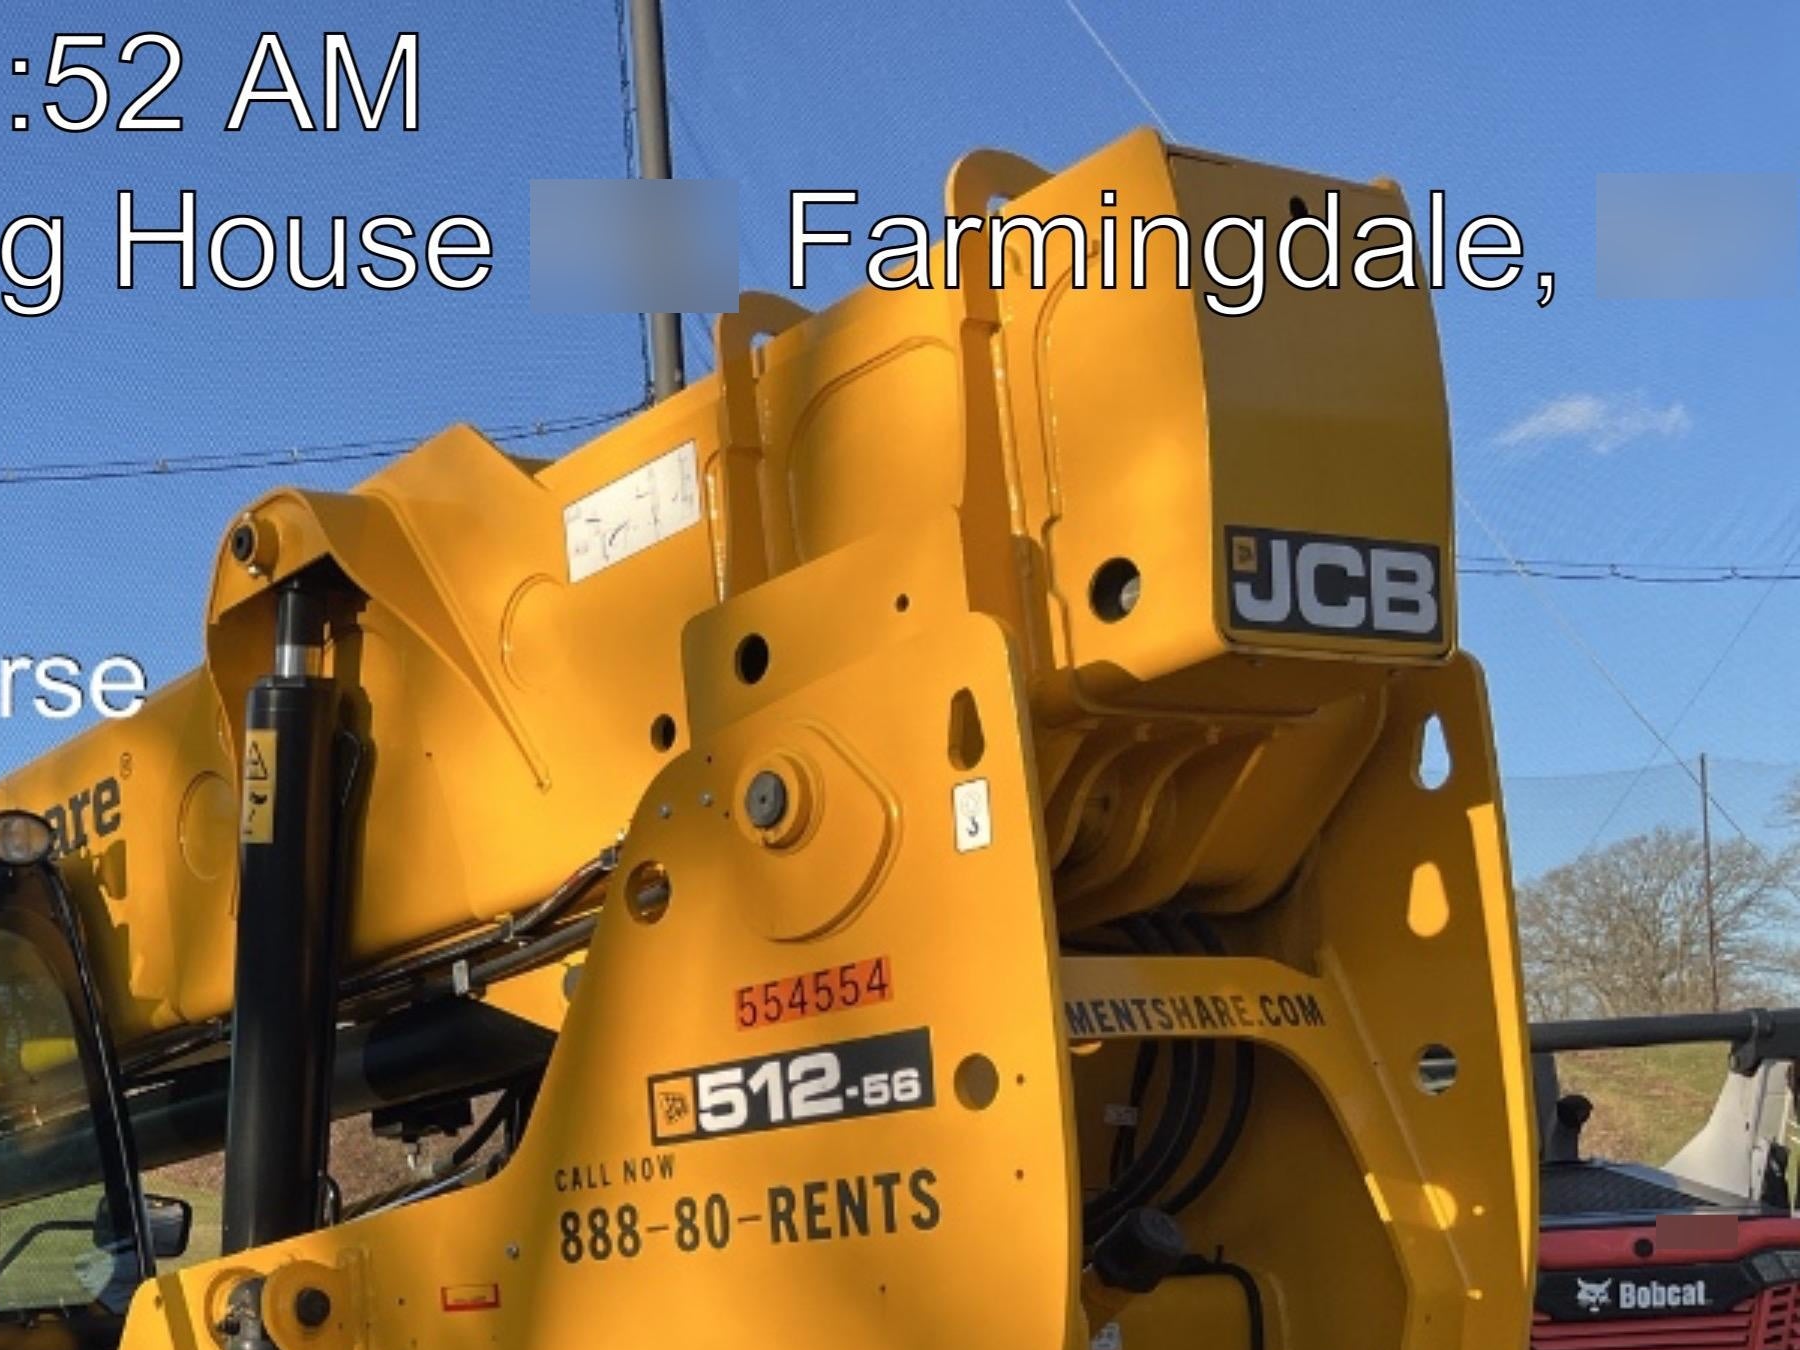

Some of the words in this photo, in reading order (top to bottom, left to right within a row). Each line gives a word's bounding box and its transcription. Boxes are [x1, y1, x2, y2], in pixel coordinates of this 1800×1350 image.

[1233, 538, 1438, 634] JCB
[737, 957, 889, 1029] 554554
[697, 1051, 922, 1133] 512-56
[555, 1161, 611, 1193] CALL
[623, 1153, 675, 1185] NOW
[560, 1167, 940, 1264] 888-80-RENTS
[1619, 1280, 1706, 1309] Bobcat
